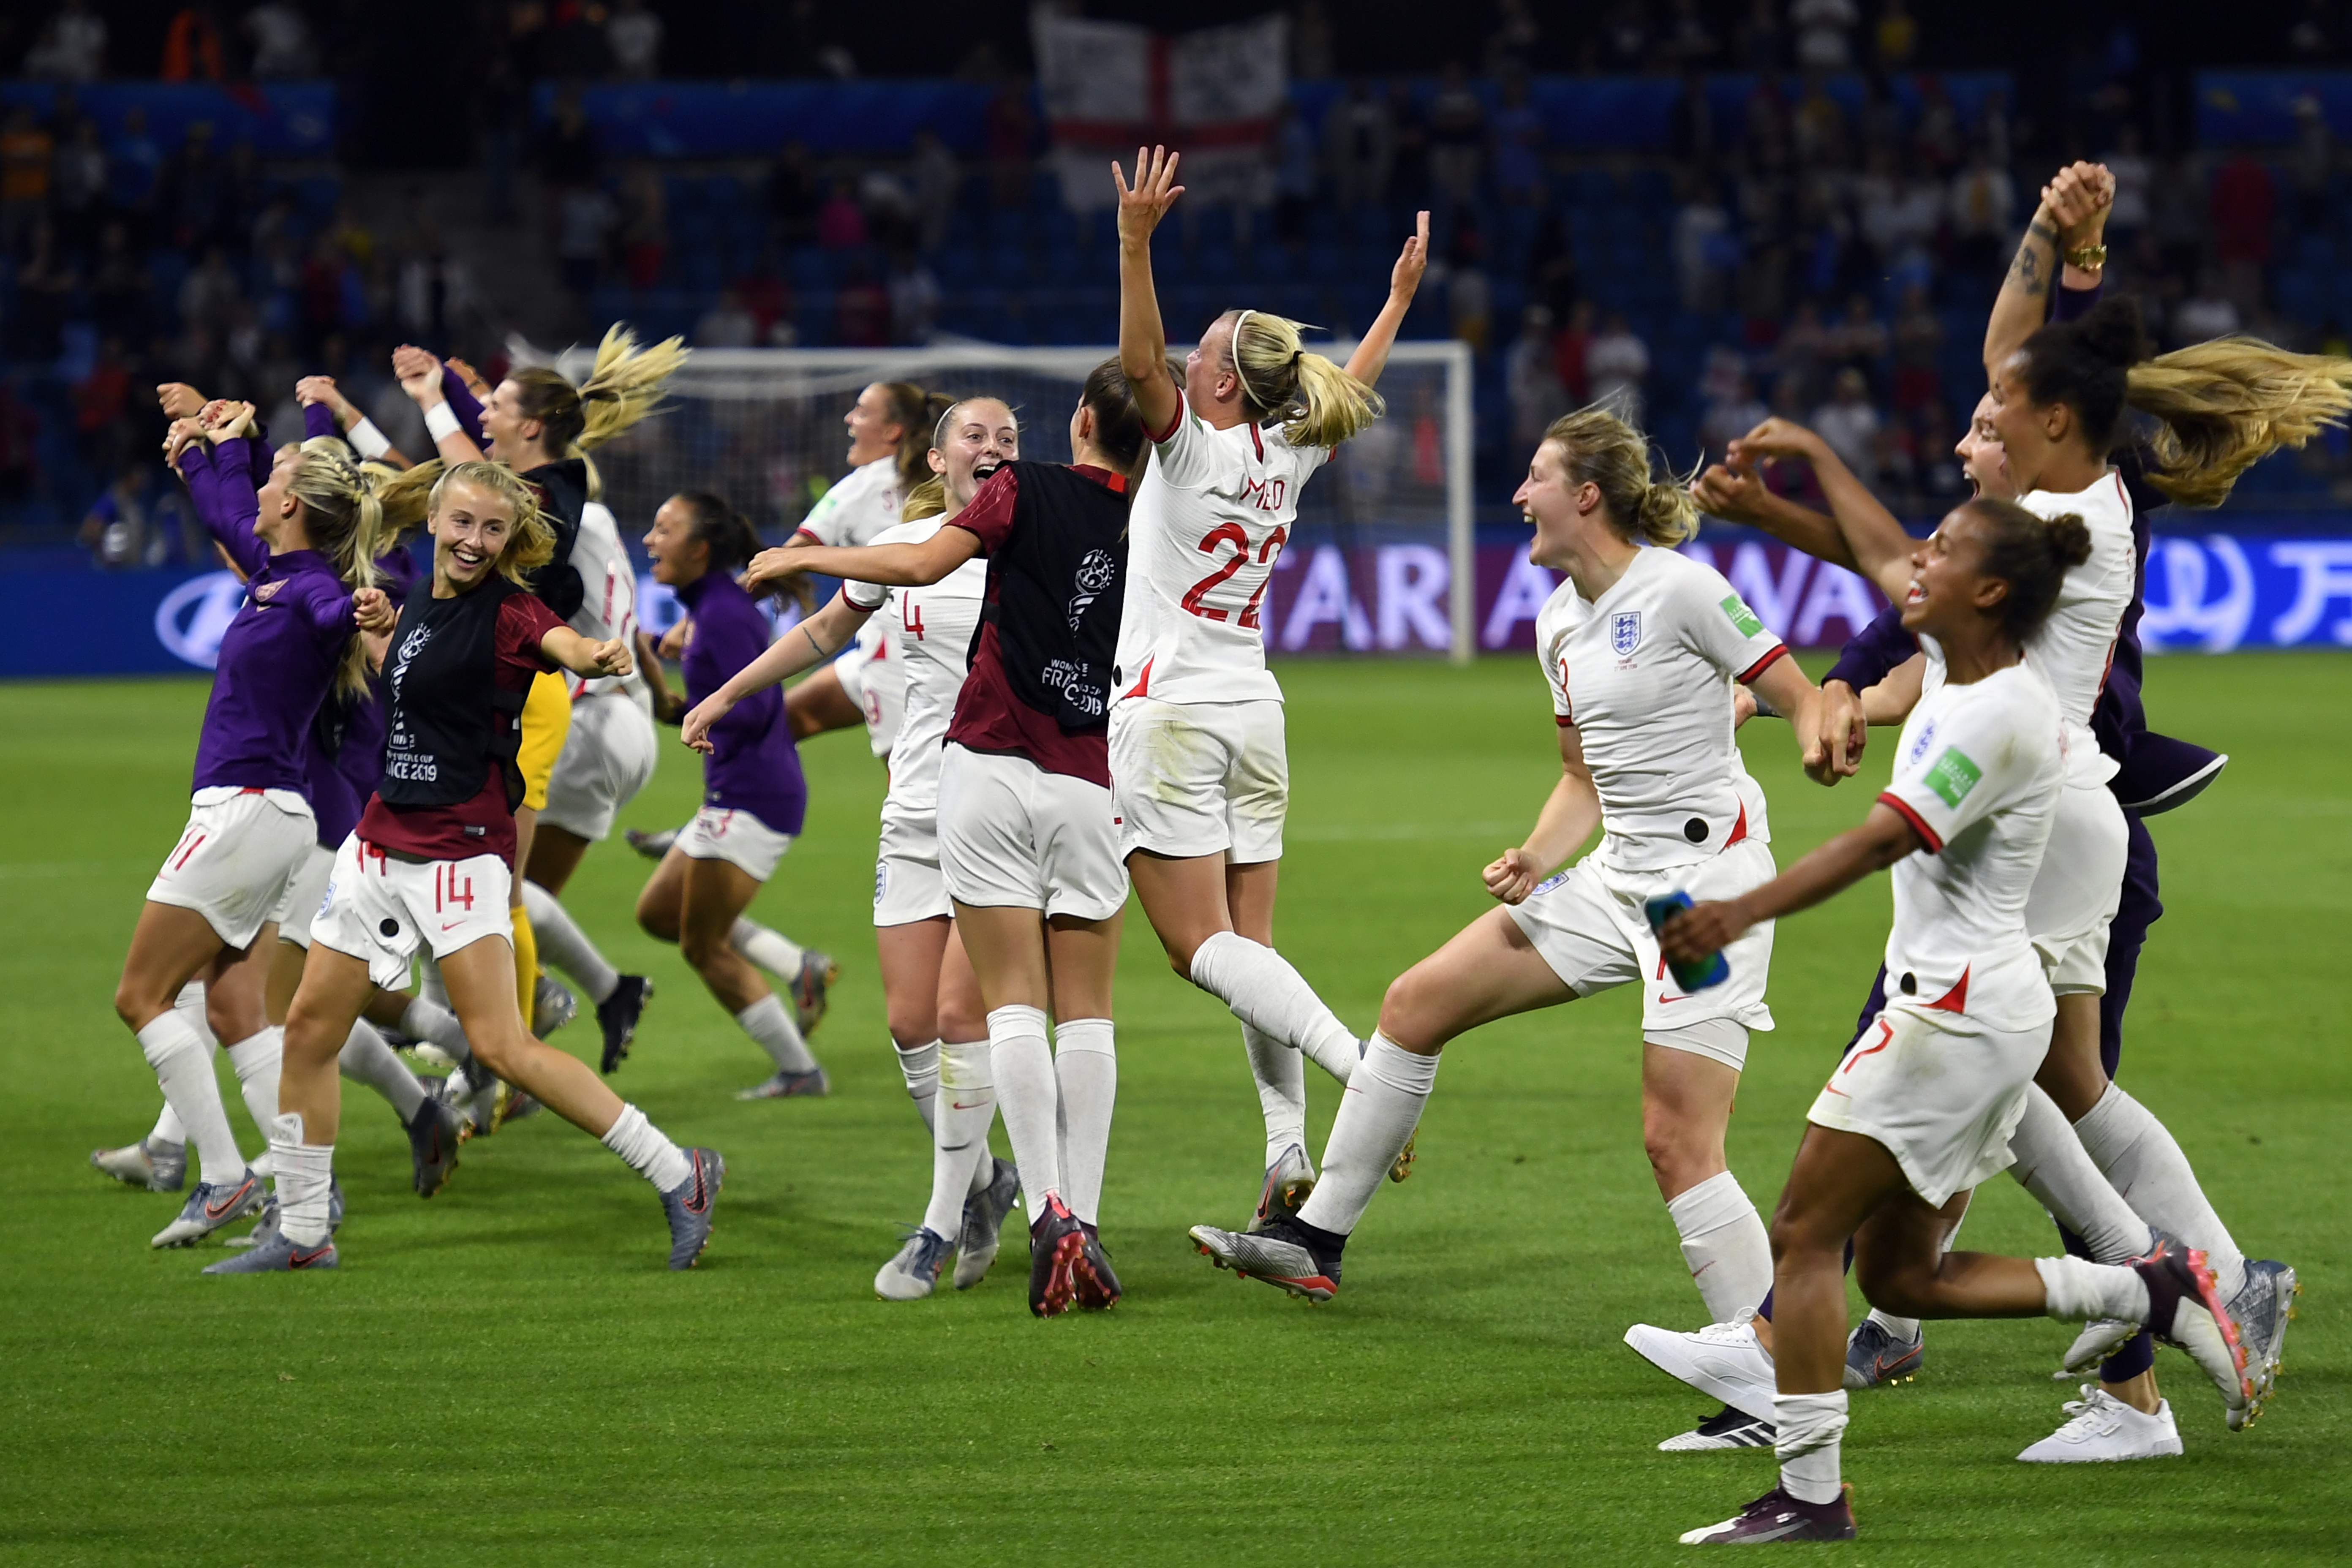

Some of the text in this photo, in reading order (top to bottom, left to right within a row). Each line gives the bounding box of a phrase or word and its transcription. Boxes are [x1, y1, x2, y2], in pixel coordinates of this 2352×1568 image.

[1181, 522, 1287, 630] 22
[903, 590, 924, 641] 4
[410, 763, 437, 782] 2019
[168, 826, 207, 872] 11
[436, 863, 474, 914] 14
